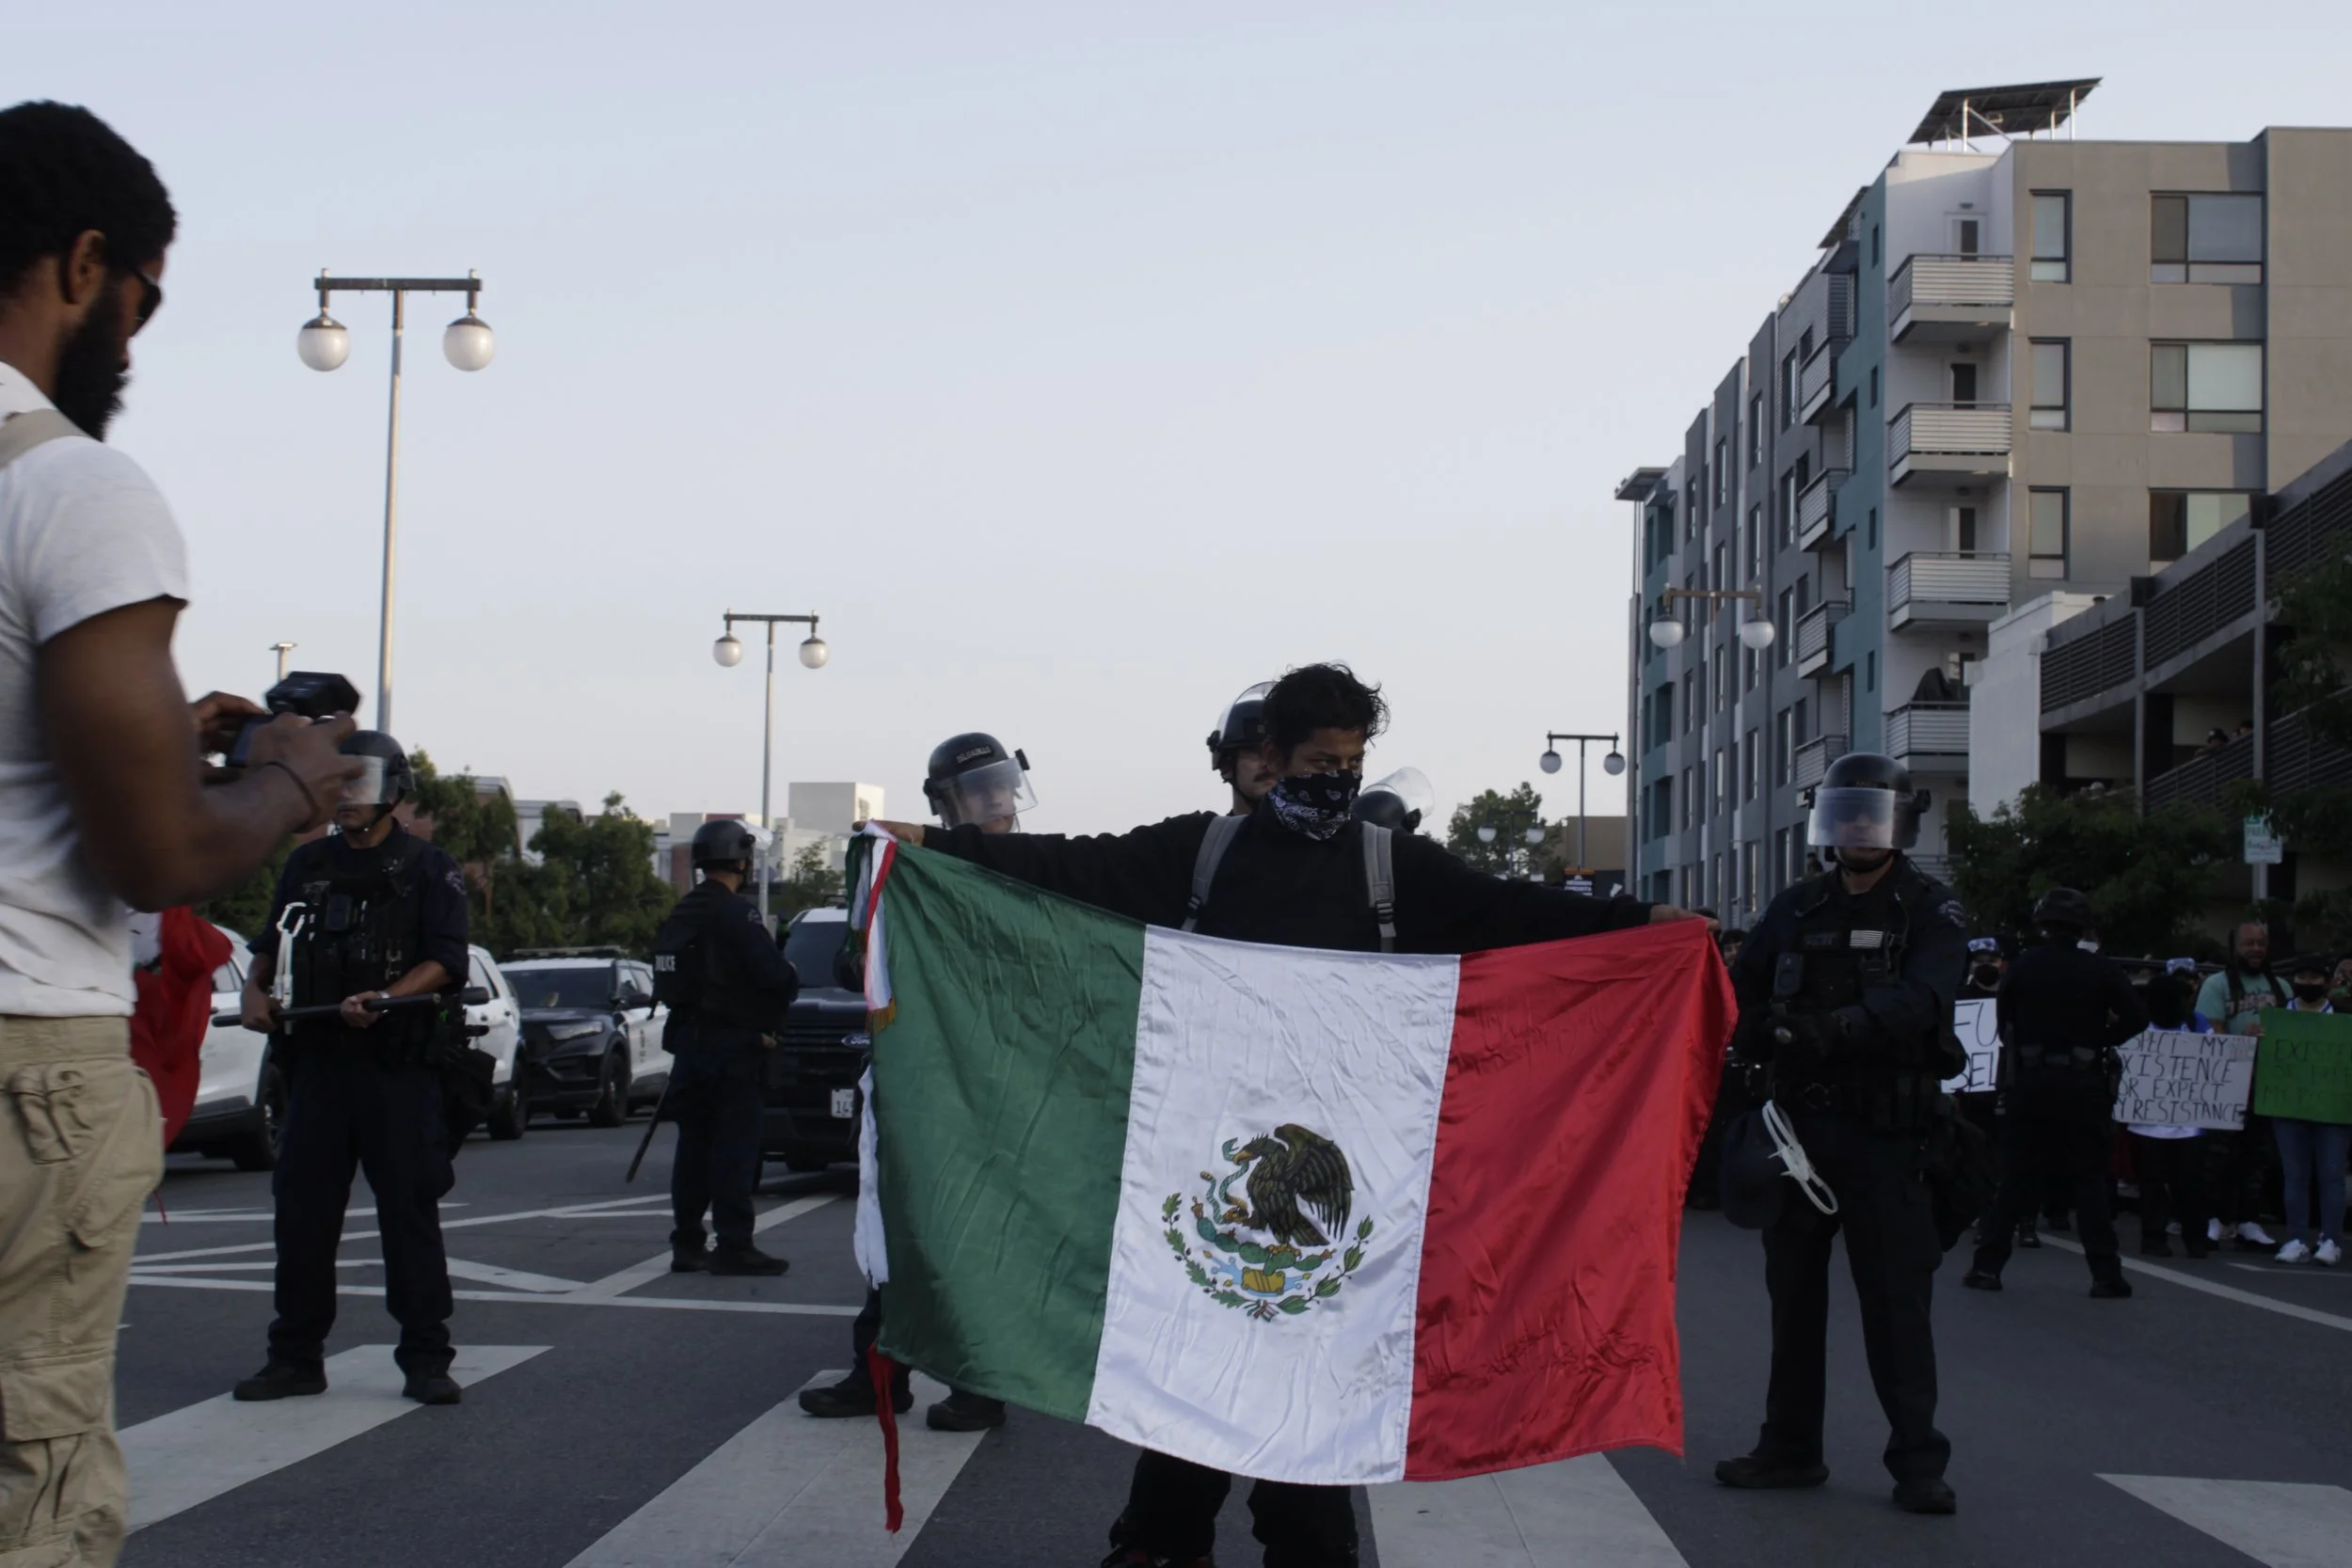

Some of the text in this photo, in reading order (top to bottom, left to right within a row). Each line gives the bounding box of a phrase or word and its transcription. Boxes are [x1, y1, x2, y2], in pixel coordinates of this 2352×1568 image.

[2200, 1037, 2228, 1057] MY
[2153, 1078, 2224, 1101] EXPECT
[2132, 1099, 2245, 1123] RESISTANCE
